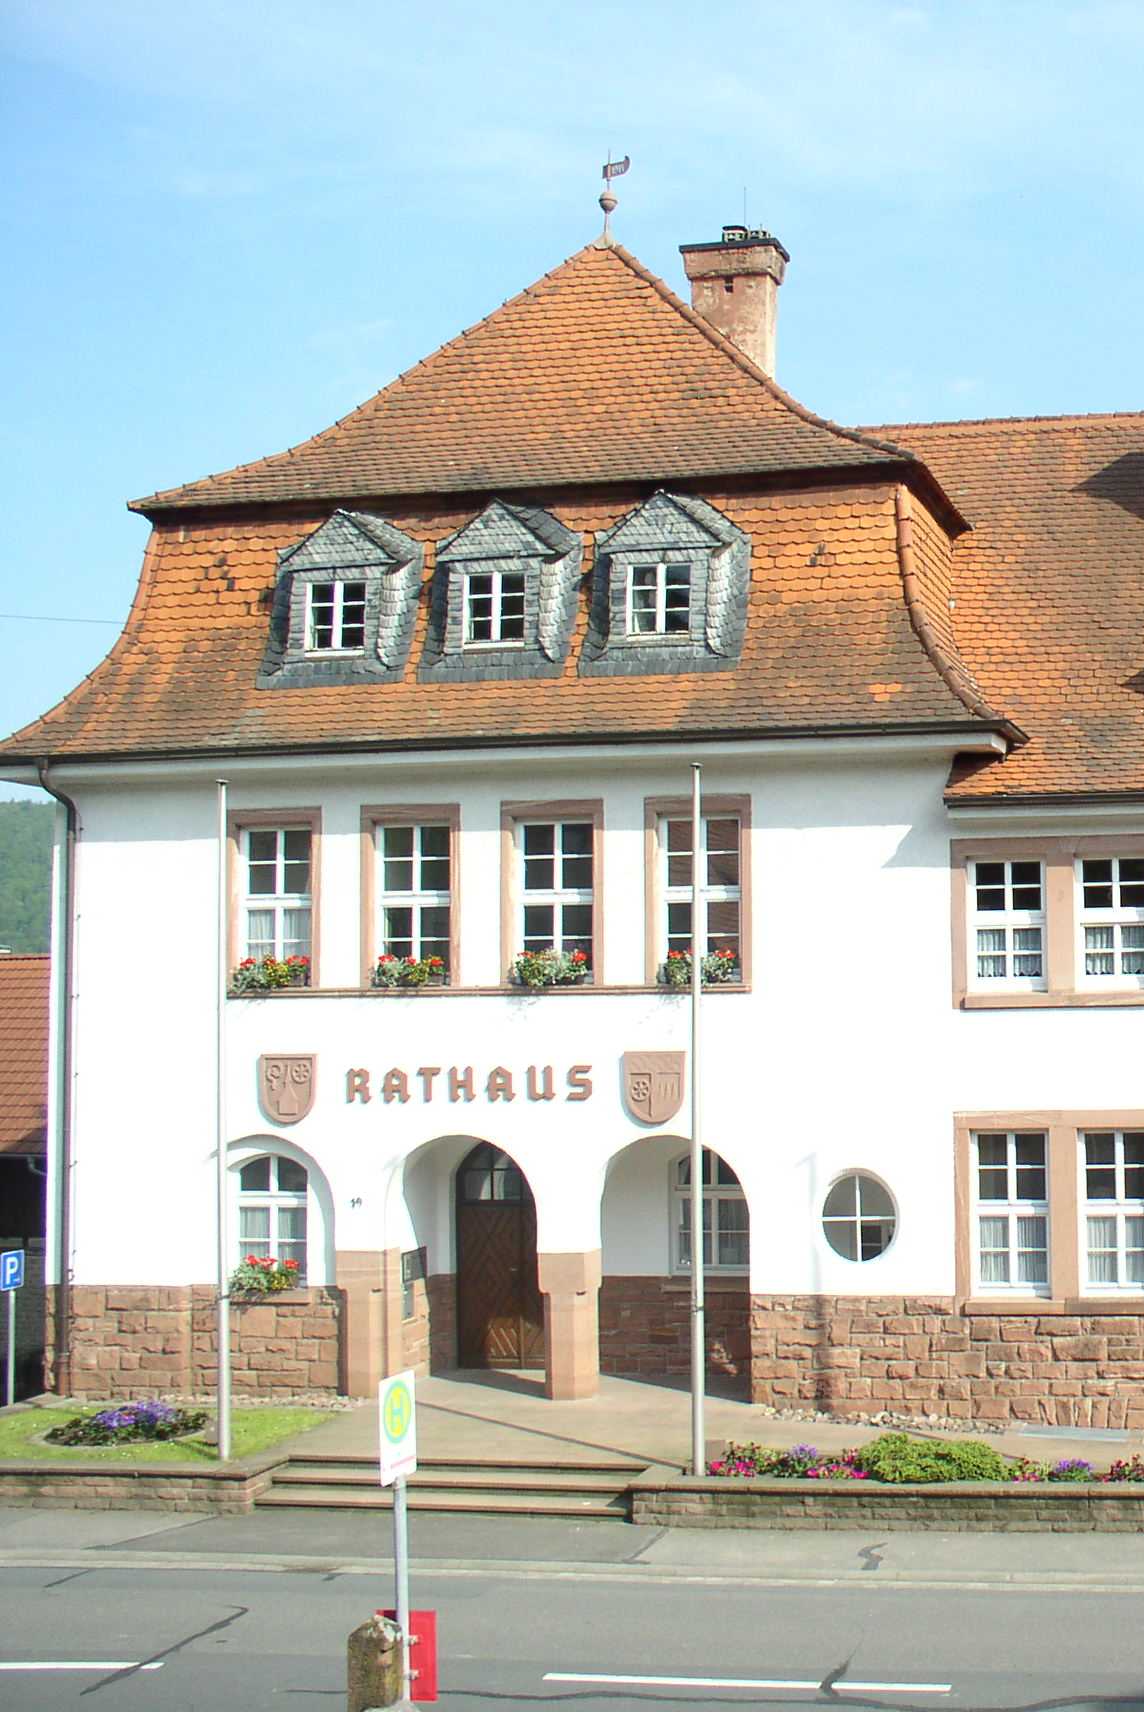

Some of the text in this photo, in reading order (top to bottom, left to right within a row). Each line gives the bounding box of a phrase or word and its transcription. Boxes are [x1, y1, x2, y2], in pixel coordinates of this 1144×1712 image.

[345, 1065, 593, 1104] RATHAUS
[6, 1256, 18, 1285] P
[391, 1393, 404, 1431] H
